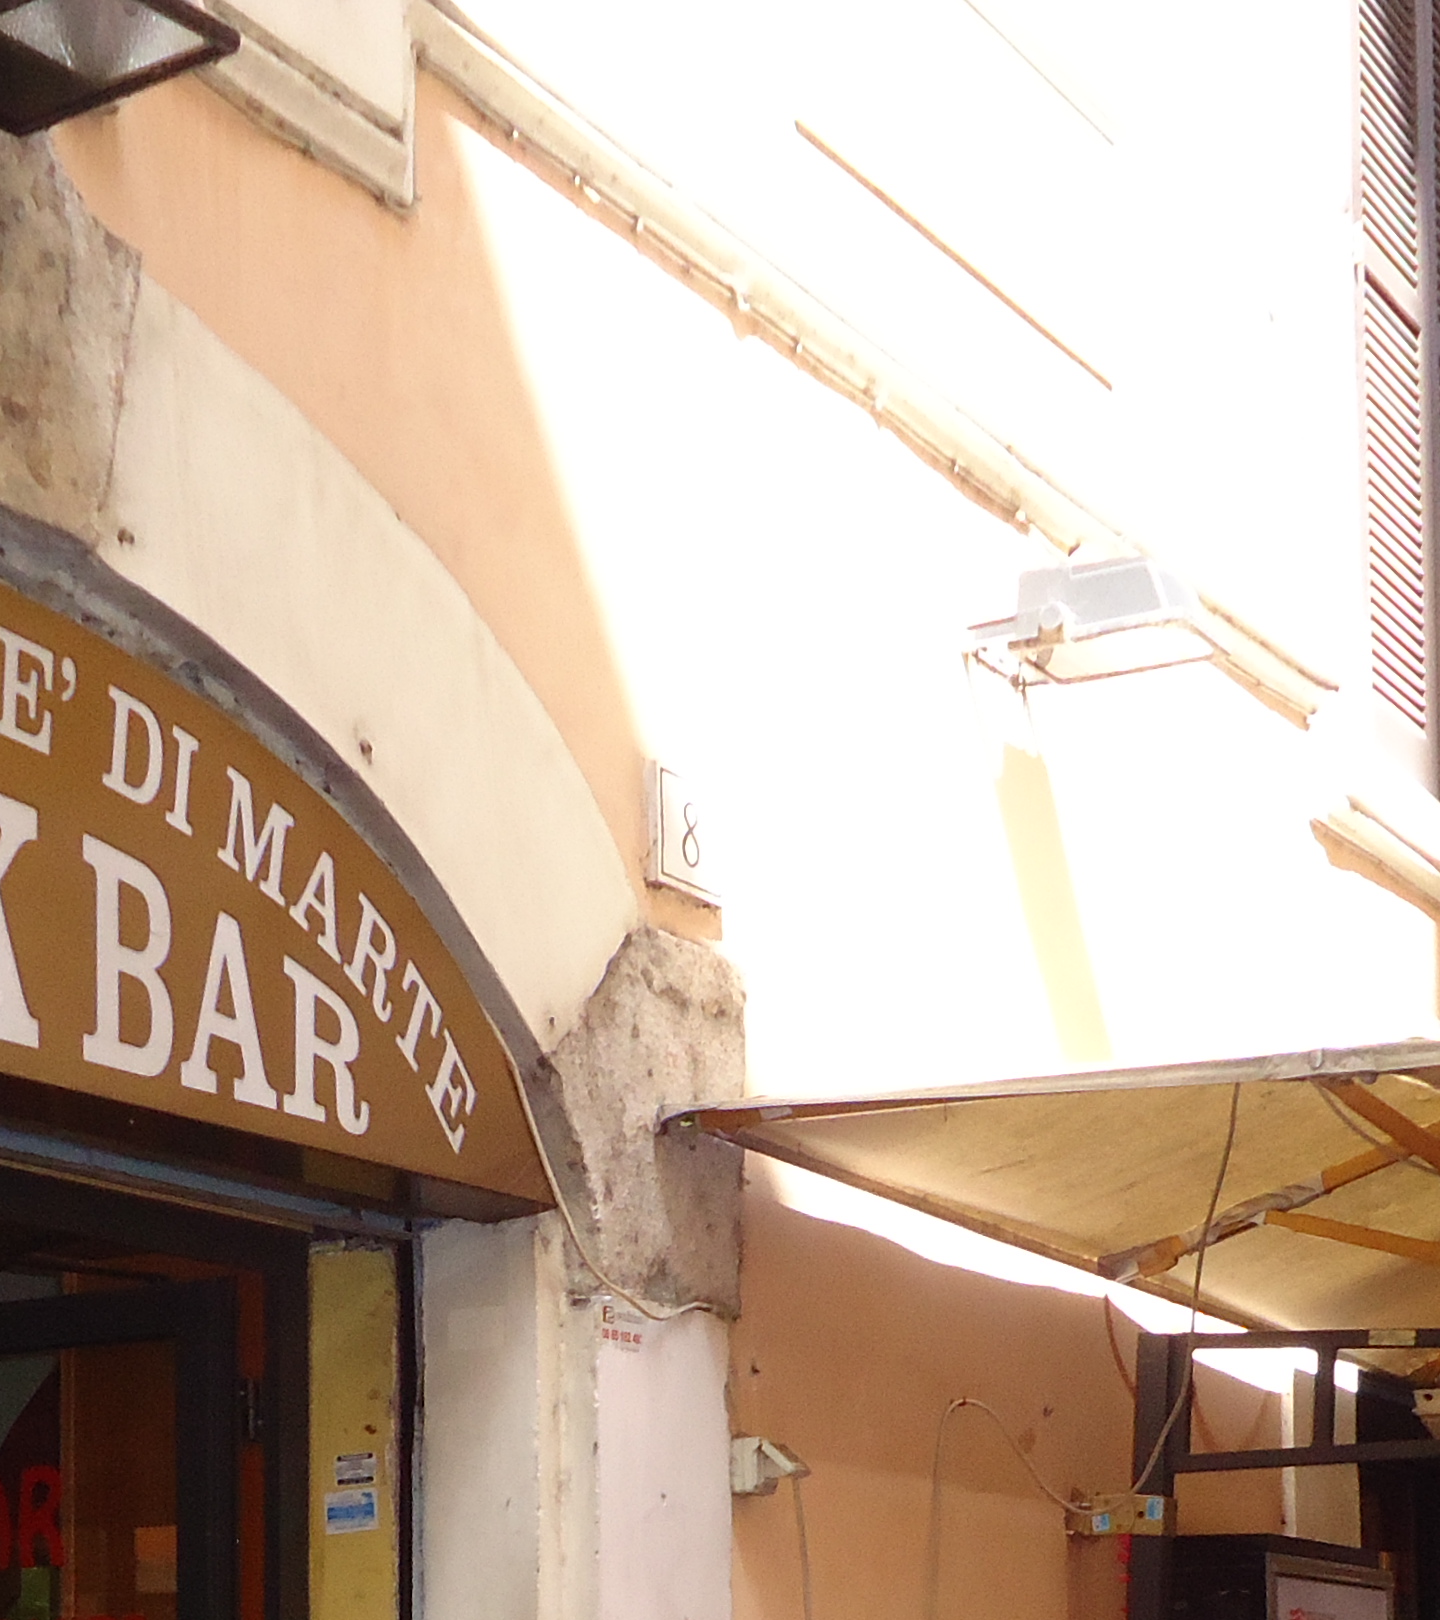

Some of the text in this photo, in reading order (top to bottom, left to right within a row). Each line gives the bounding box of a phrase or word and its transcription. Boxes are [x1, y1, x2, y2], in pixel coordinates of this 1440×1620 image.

[82, 833, 370, 1136] BAR
[101, 686, 200, 837] DI
[217, 766, 477, 1154] MARTE
[681, 802, 701, 868] 8
